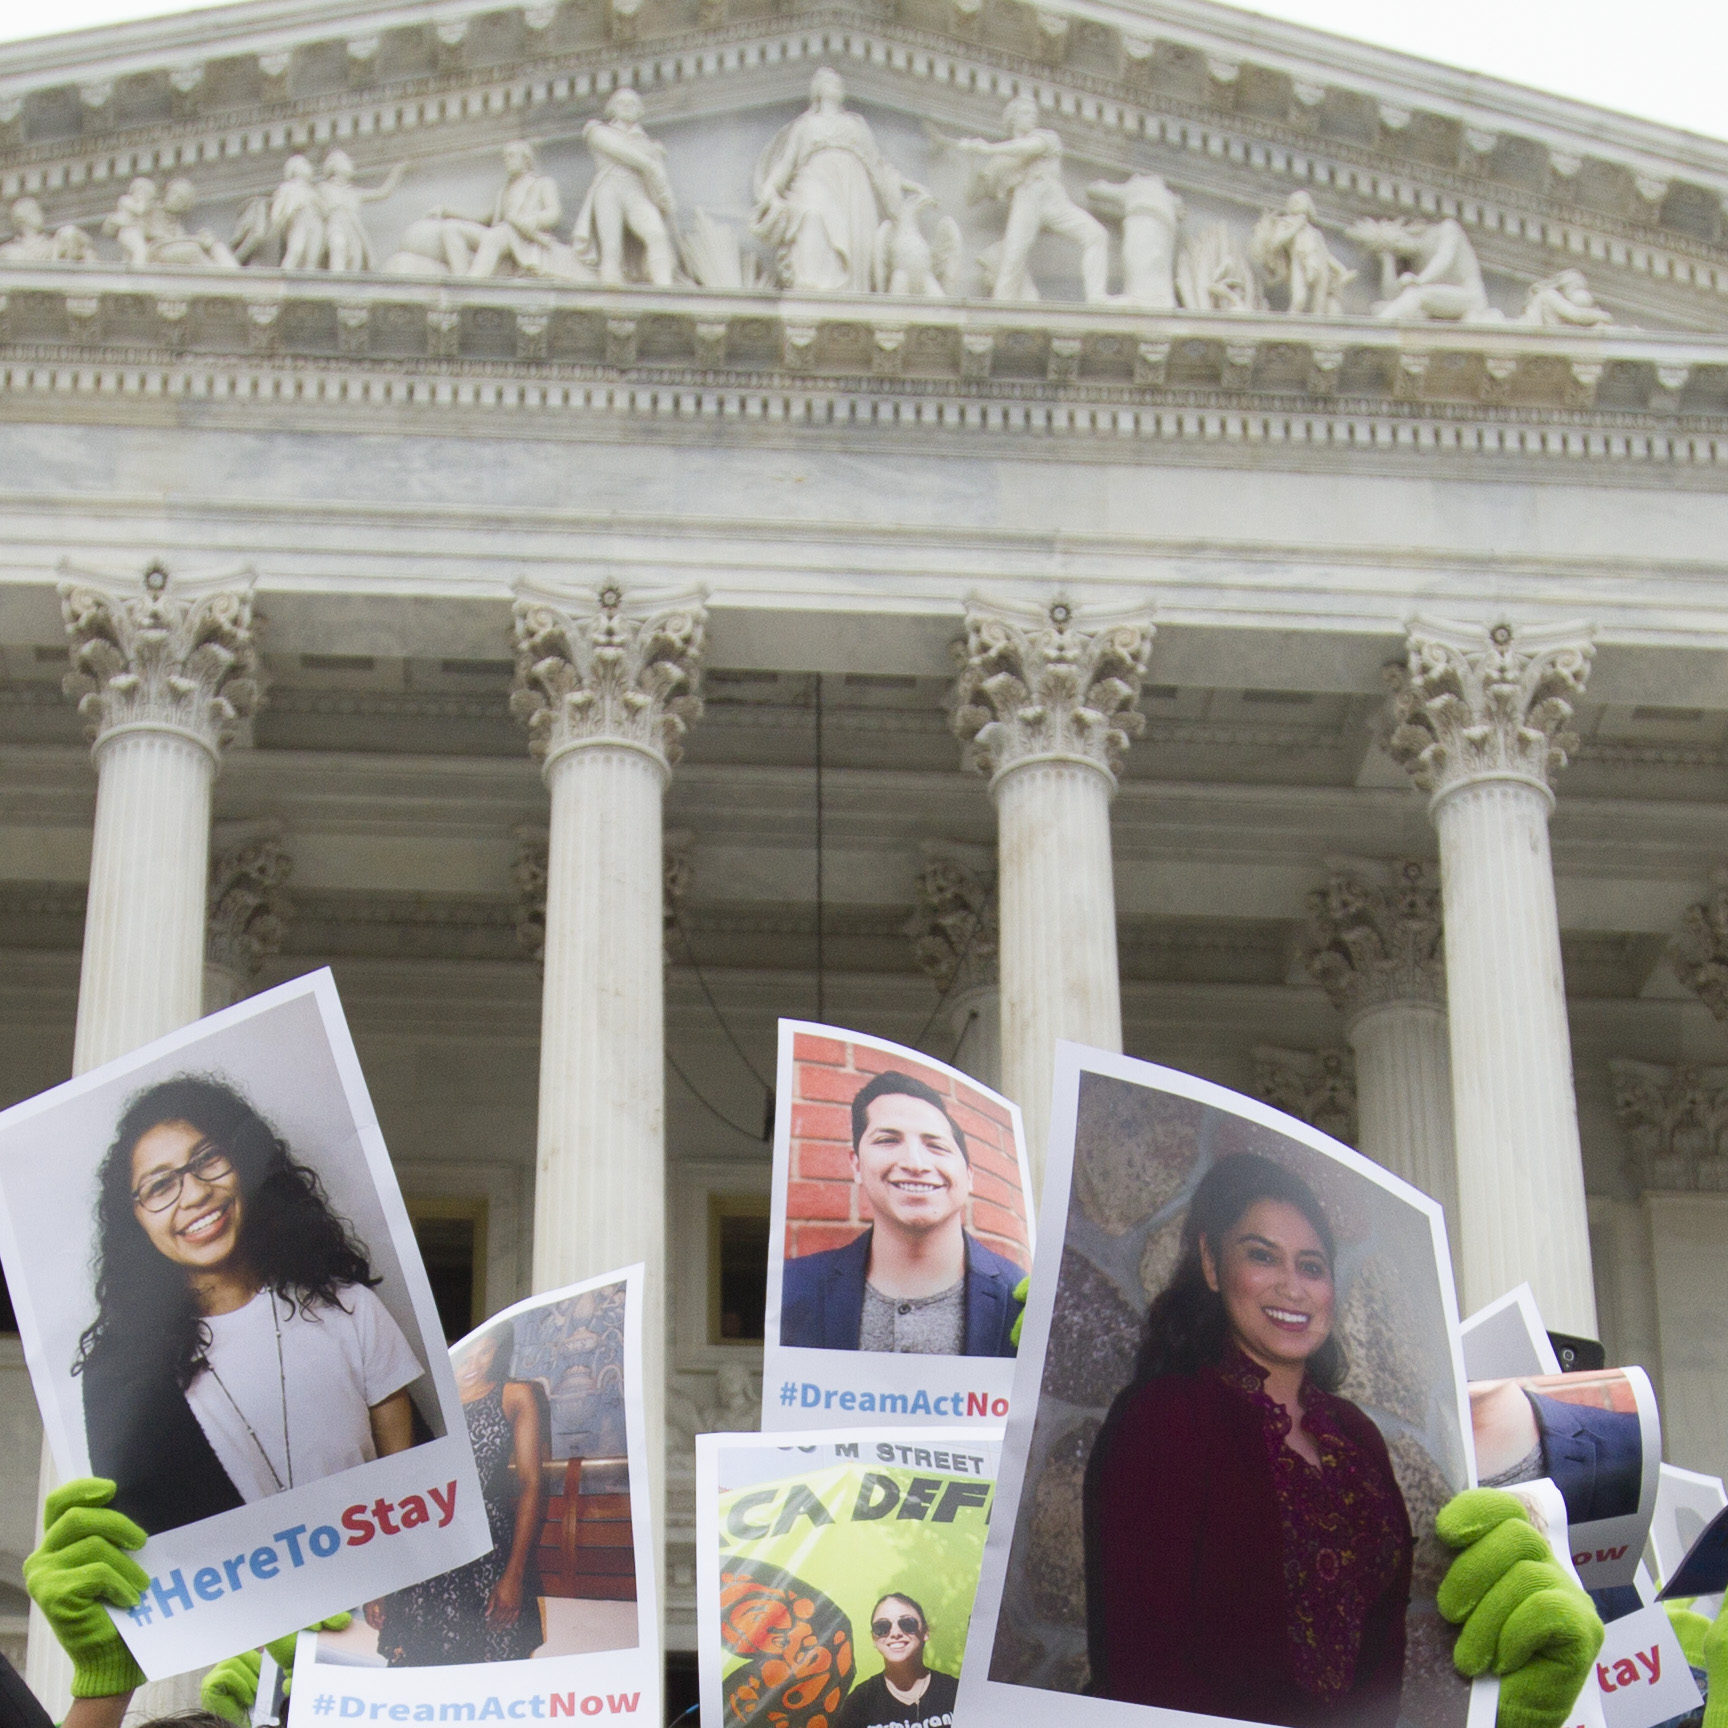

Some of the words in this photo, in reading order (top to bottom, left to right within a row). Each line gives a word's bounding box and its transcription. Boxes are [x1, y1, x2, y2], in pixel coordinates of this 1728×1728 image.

[835, 1442, 860, 1458] M
[876, 1442, 984, 1475] STREET
[719, 1483, 836, 1547] CA
[850, 1472, 995, 1526] DEF
[125, 1480, 458, 1627] #HereToStay
[311, 1691, 641, 1722] #DreamActNow
